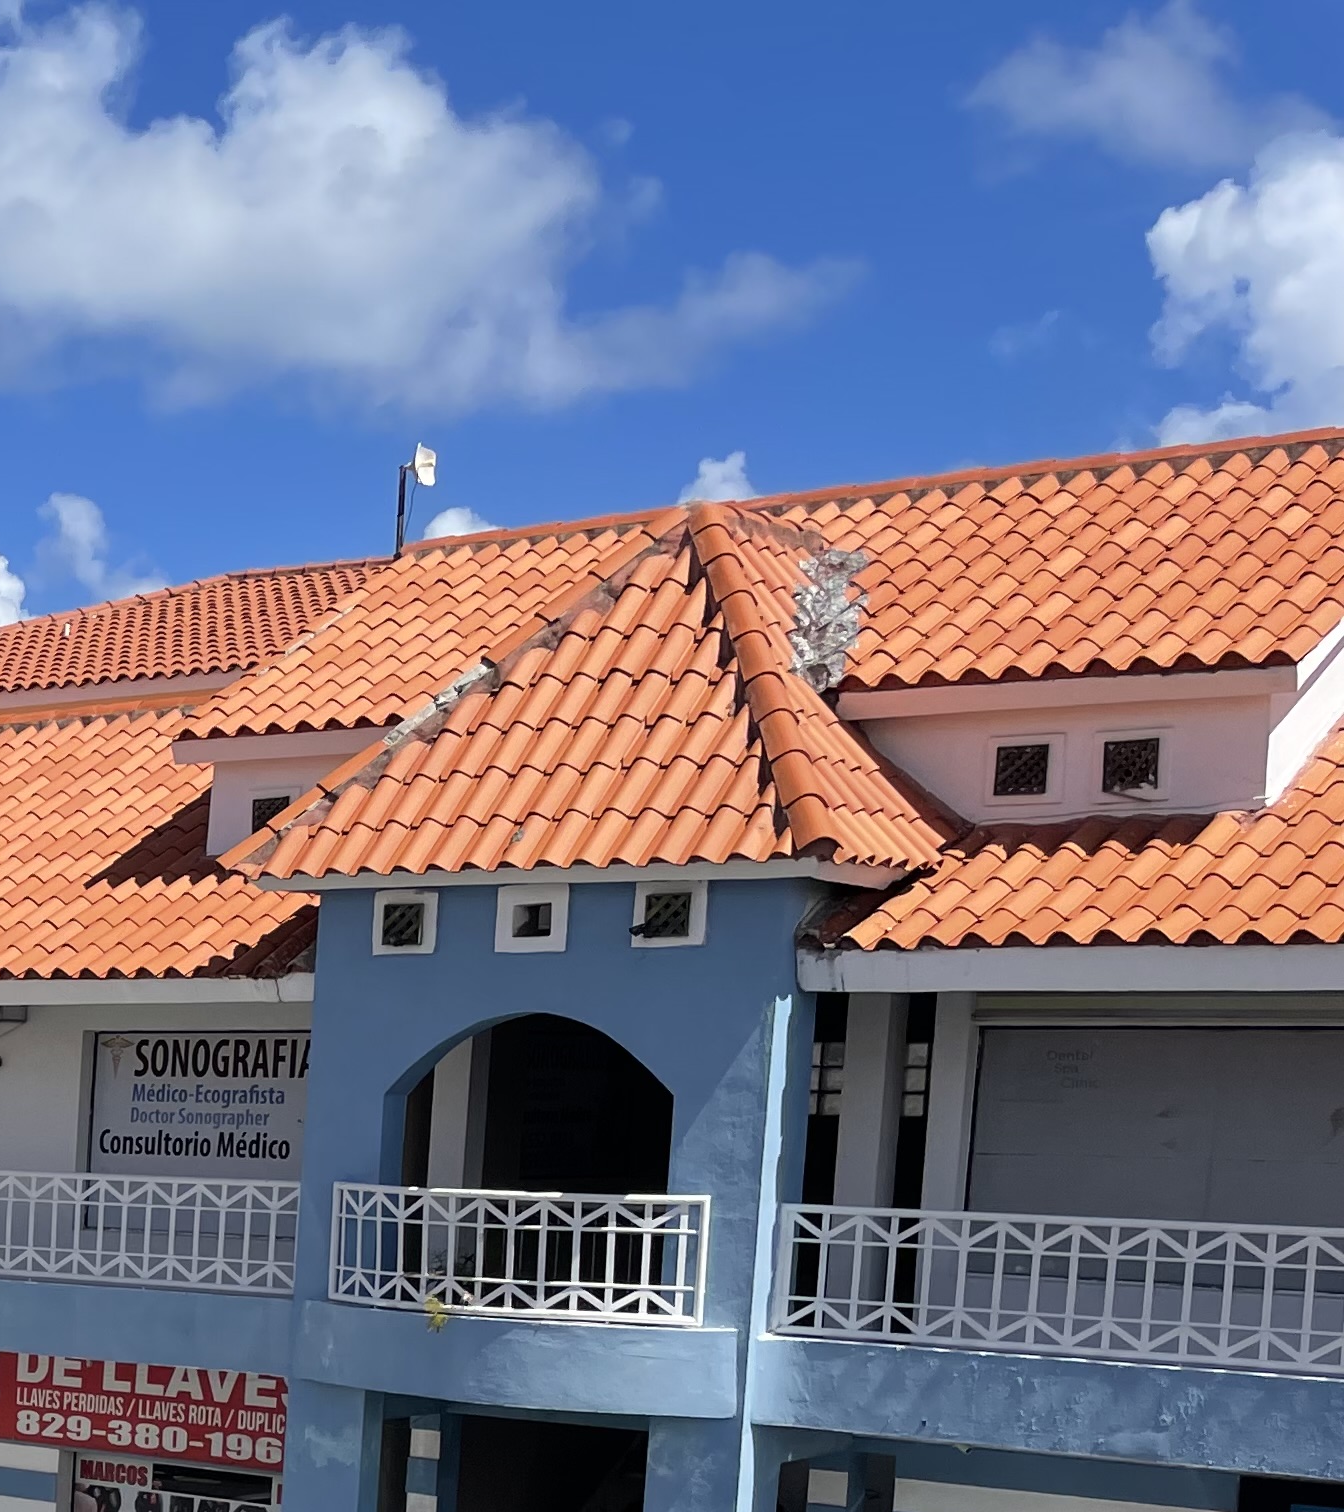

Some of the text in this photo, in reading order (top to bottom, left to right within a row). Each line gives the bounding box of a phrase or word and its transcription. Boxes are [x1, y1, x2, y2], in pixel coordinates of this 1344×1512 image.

[133, 1038, 310, 1079] SONOGRAFIA
[132, 1083, 285, 1108] Médico-Ecografista
[130, 1107, 270, 1130] Doctor Sonographer
[99, 1129, 290, 1161] Consultorio Médico
[16, 1352, 83, 1388] DE
[102, 1360, 288, 1408] LLAVE
[16, 1386, 60, 1409] LLAVES
[63, 1392, 124, 1416] PERDIDAS
[138, 1400, 185, 1424] LLAVES
[189, 1404, 222, 1428] ROTA
[79, 1459, 148, 1487] MARCOS
